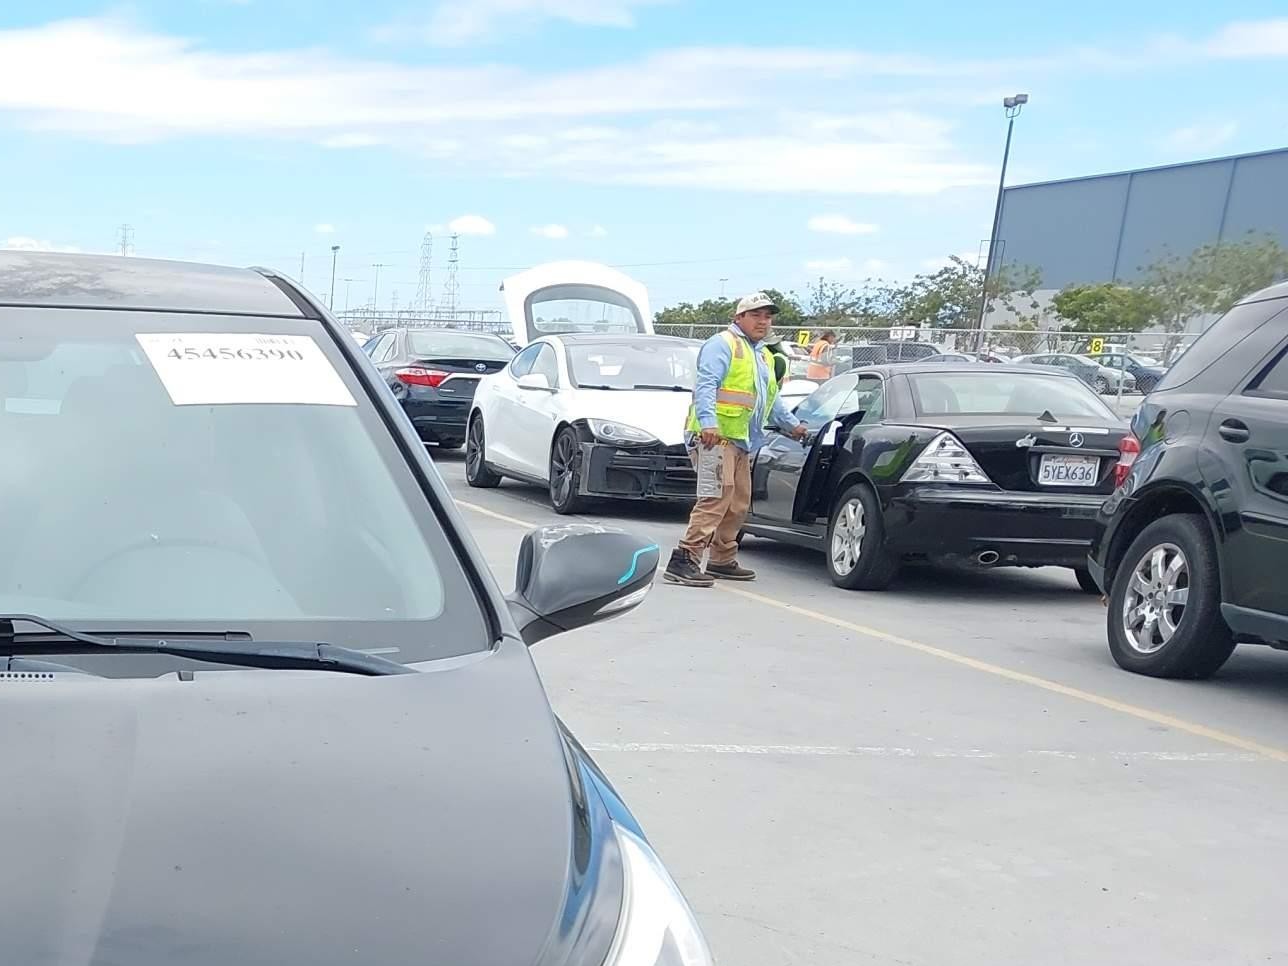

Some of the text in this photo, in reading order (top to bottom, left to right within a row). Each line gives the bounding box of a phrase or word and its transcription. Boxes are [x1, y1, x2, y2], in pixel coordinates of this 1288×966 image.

[800, 332, 808, 345] 7
[1093, 340, 1101, 352] 8
[167, 347, 304, 361] 45456390
[1043, 465, 1093, 481] 5YEX636
